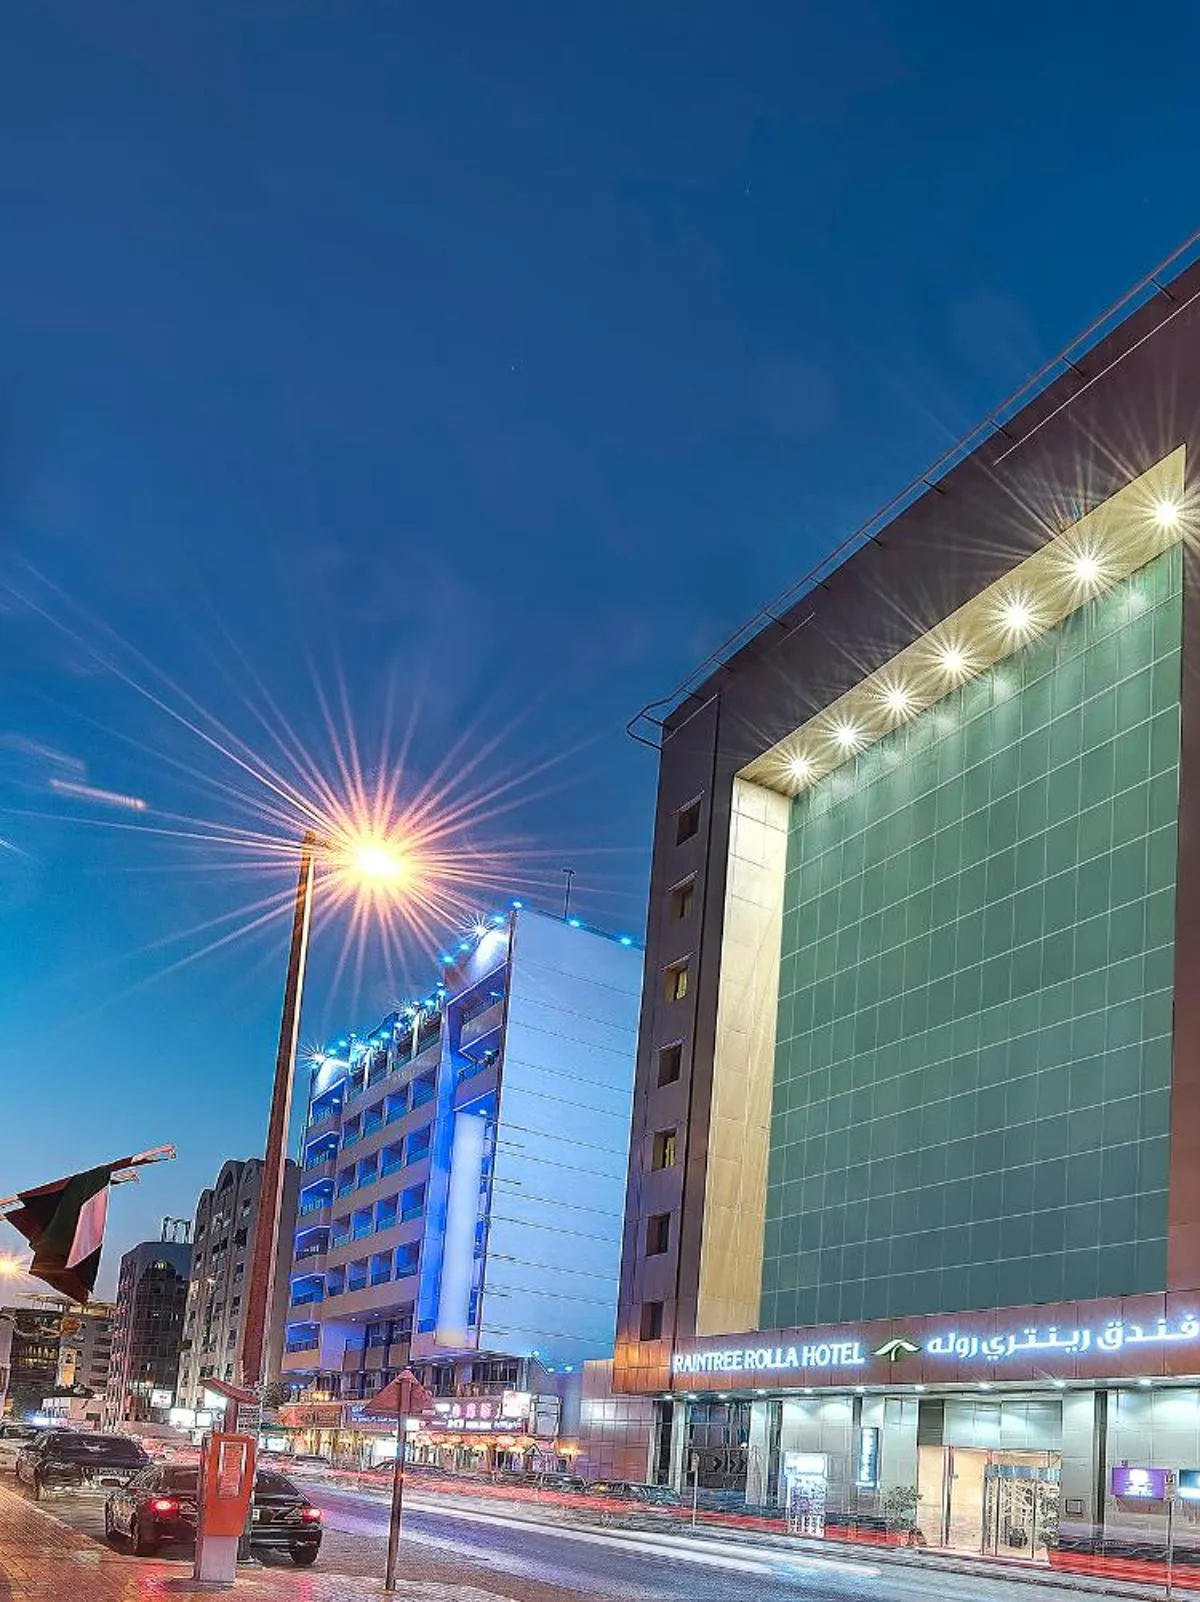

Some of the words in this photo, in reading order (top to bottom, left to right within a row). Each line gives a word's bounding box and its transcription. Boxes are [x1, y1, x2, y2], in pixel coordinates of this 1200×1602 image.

[982, 1327, 1091, 1360] رينتري
[1096, 1314, 1200, 1350] فندق
[673, 1350, 744, 1373] RAINTREE
[745, 1347, 799, 1369] ROLLA
[802, 1342, 865, 1366] HOTEL
